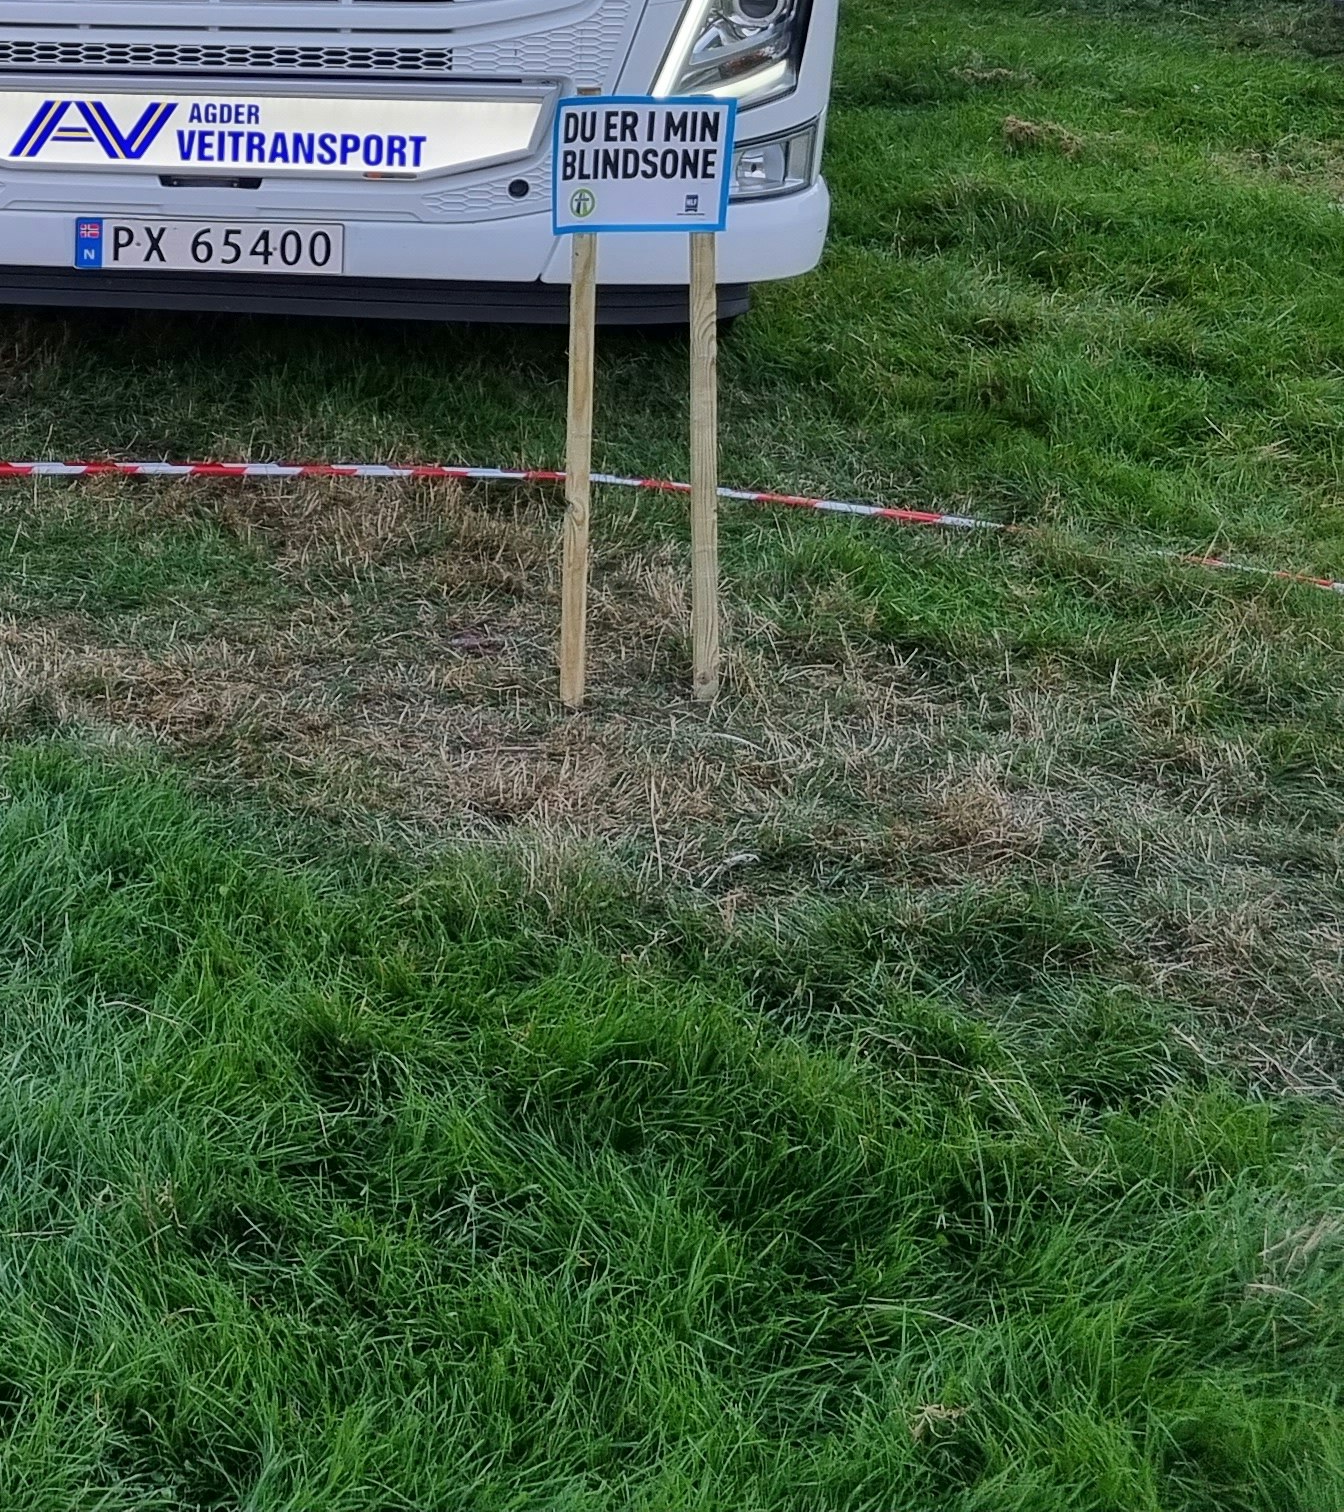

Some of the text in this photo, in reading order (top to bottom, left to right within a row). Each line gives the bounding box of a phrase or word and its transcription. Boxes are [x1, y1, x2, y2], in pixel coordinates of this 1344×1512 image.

[188, 103, 260, 125] AGDER
[564, 110, 720, 144] DU ER I MIN
[176, 129, 427, 167] VEITRANSPORT
[562, 148, 717, 181] BLINDSONE
[84, 248, 94, 260] N
[113, 226, 331, 266] PX 65400
